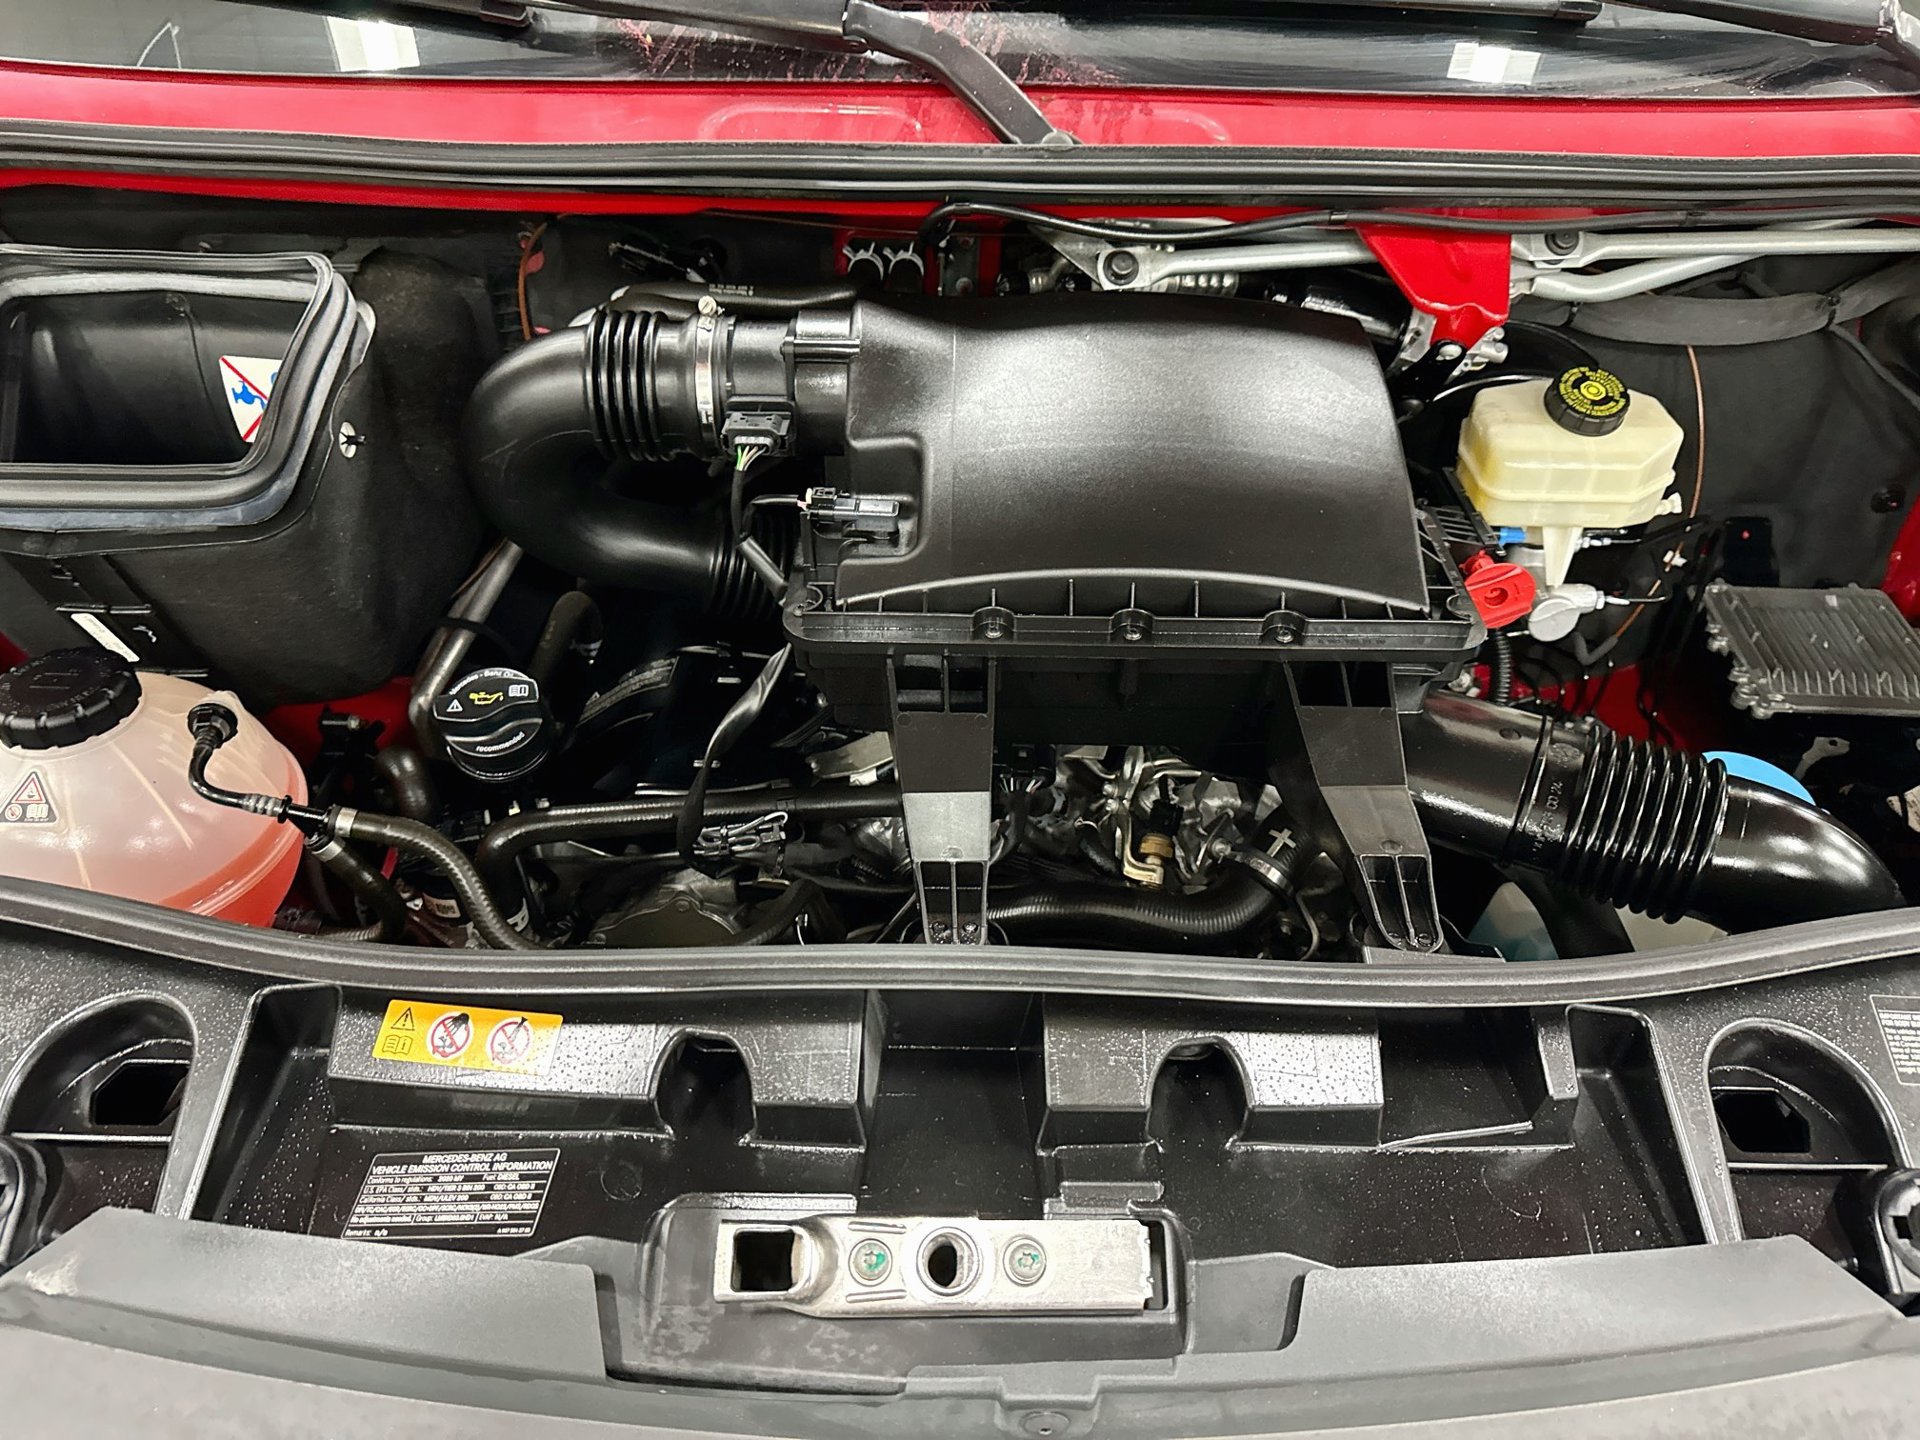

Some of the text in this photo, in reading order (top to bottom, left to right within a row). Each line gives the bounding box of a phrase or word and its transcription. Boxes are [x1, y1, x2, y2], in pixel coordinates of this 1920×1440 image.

[476, 731, 525, 752] recommended
[422, 1153, 508, 1164] MERCEDES-BENZ AG
[372, 1161, 554, 1175] VEHICLE EMISSION CONTROL INFORMATION
[402, 1177, 434, 1185] regulations:
[498, 1173, 520, 1181] DIESEL
